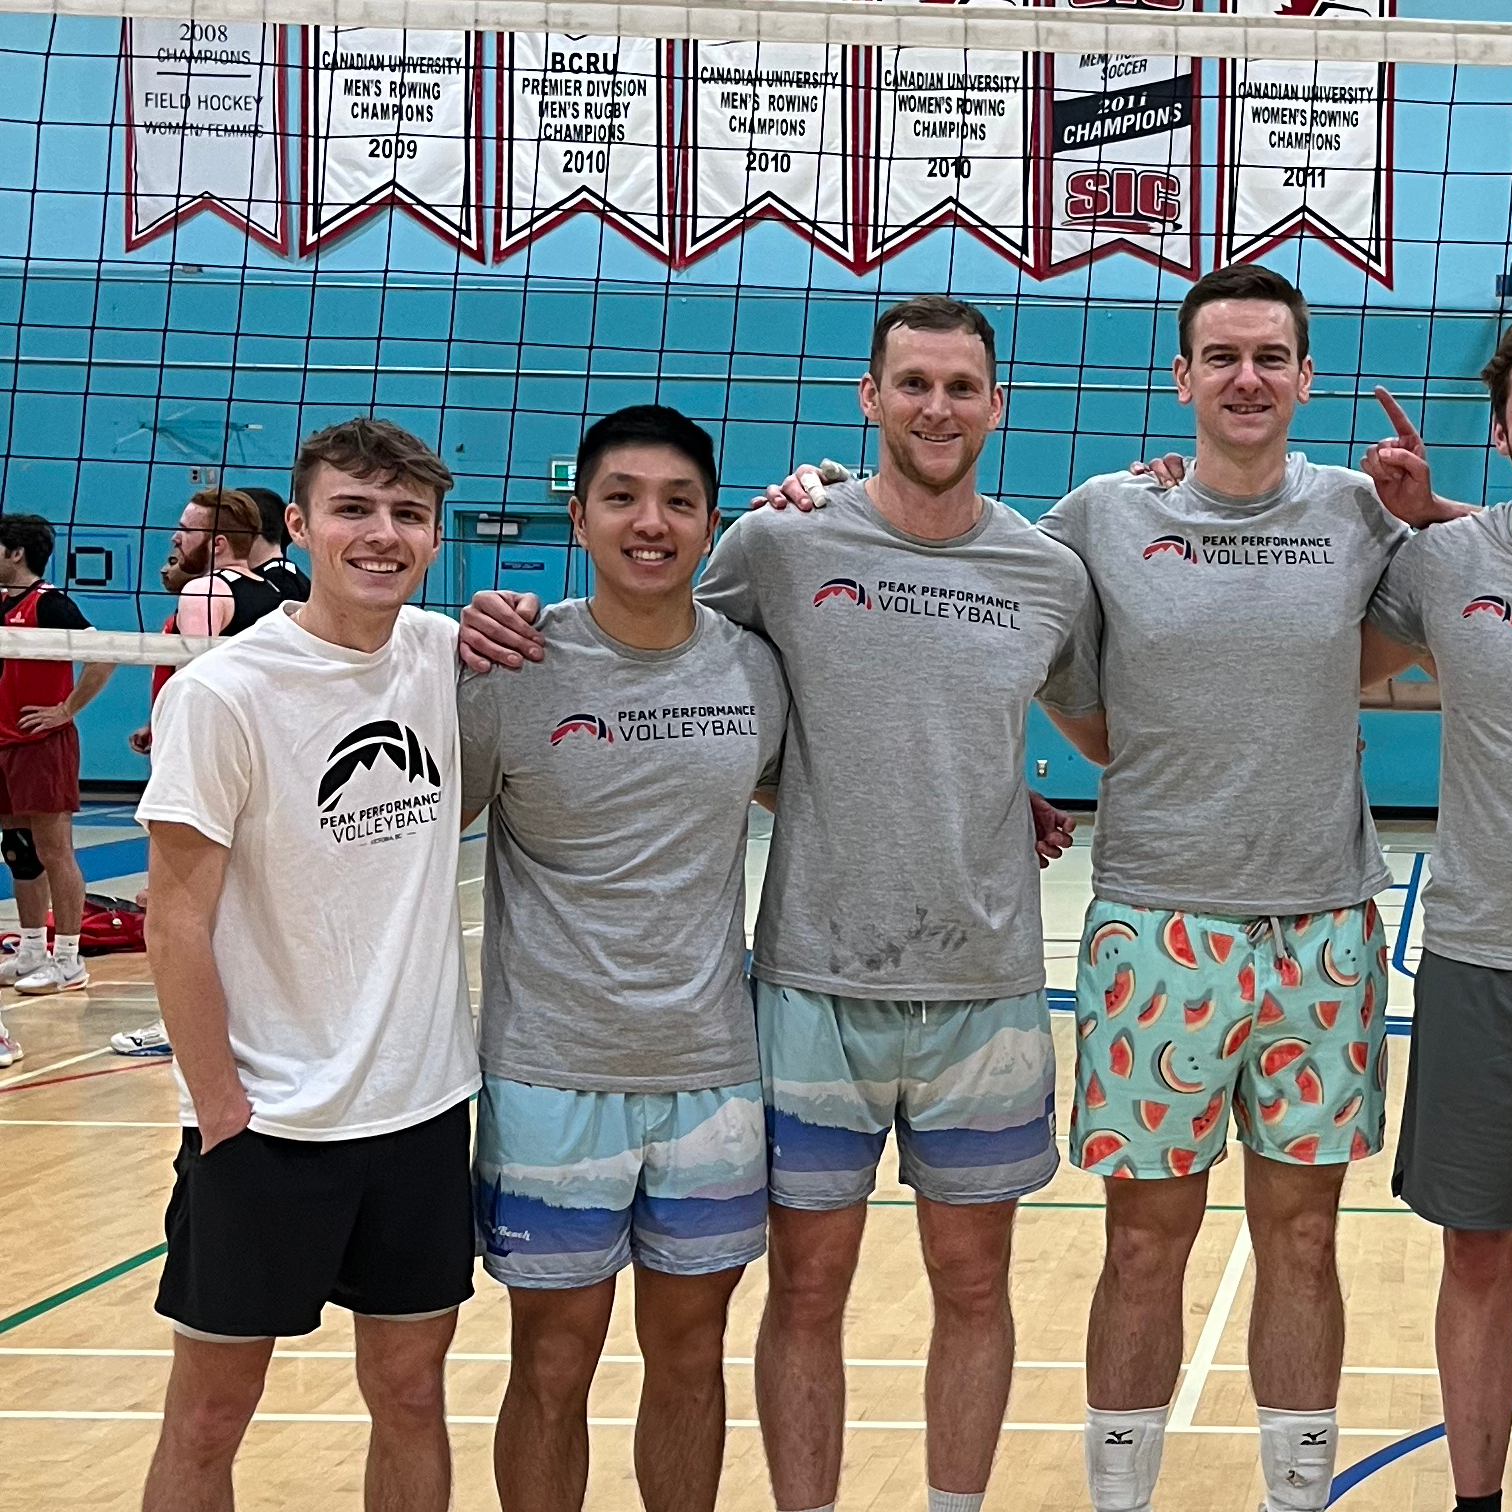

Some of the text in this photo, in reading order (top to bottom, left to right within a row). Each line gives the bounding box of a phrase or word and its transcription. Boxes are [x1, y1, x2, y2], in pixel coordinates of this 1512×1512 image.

[180, 24, 228, 42] 2008
[158, 48, 250, 64] CHAMPIONS
[322, 51, 462, 75] CANADIAN UNIVERSITY
[551, 52, 617, 74] BCRU
[701, 66, 838, 89] CANADIAN UNIVERSITY
[1101, 59, 1147, 80] SOCCER
[344, 79, 441, 100] MEN'S ROWING
[522, 78, 646, 97] PREMIER DIVISION
[884, 70, 1020, 93] CANADIAN UNIVERSITY
[145, 92, 263, 111] FIELD HOCKEY
[720, 91, 818, 112] MEN'S ROWING
[1097, 91, 1147, 115] 2011
[1238, 82, 1374, 104] CANADIAN UNIVERSITY
[351, 102, 433, 122] CHAMPIONS
[539, 101, 630, 119] MEN'S RUGBY
[898, 94, 1005, 117] WOMEN'S ROWING
[729, 115, 805, 136] CHAMPIONS
[1063, 102, 1182, 144] CHAMPIONS
[1251, 106, 1359, 127] WOMEN'S ROWING
[544, 123, 625, 141] CHAMPIONS
[914, 119, 986, 140] CHAMPIONS
[368, 138, 417, 159] 2009
[1269, 131, 1341, 151] CHAMPIONS
[562, 150, 605, 173] 2010
[745, 152, 791, 172] 2010
[927, 158, 971, 178] 2010
[1283, 168, 1326, 188] 2011
[1065, 168, 1180, 222] SIC
[1202, 535, 1331, 547] PEAK PERFORMANCE
[1202, 549, 1334, 565] VOLLEYBALL
[878, 581, 1020, 611] PEAK PERFORMANCE
[878, 595, 1020, 630] VOLLEYBALL
[618, 705, 755, 722] PEAK PERFORMANCE
[619, 719, 757, 742] VOLLEYBALL
[320, 812, 356, 829] PEAK
[332, 807, 437, 843] VOLLEYBALL
